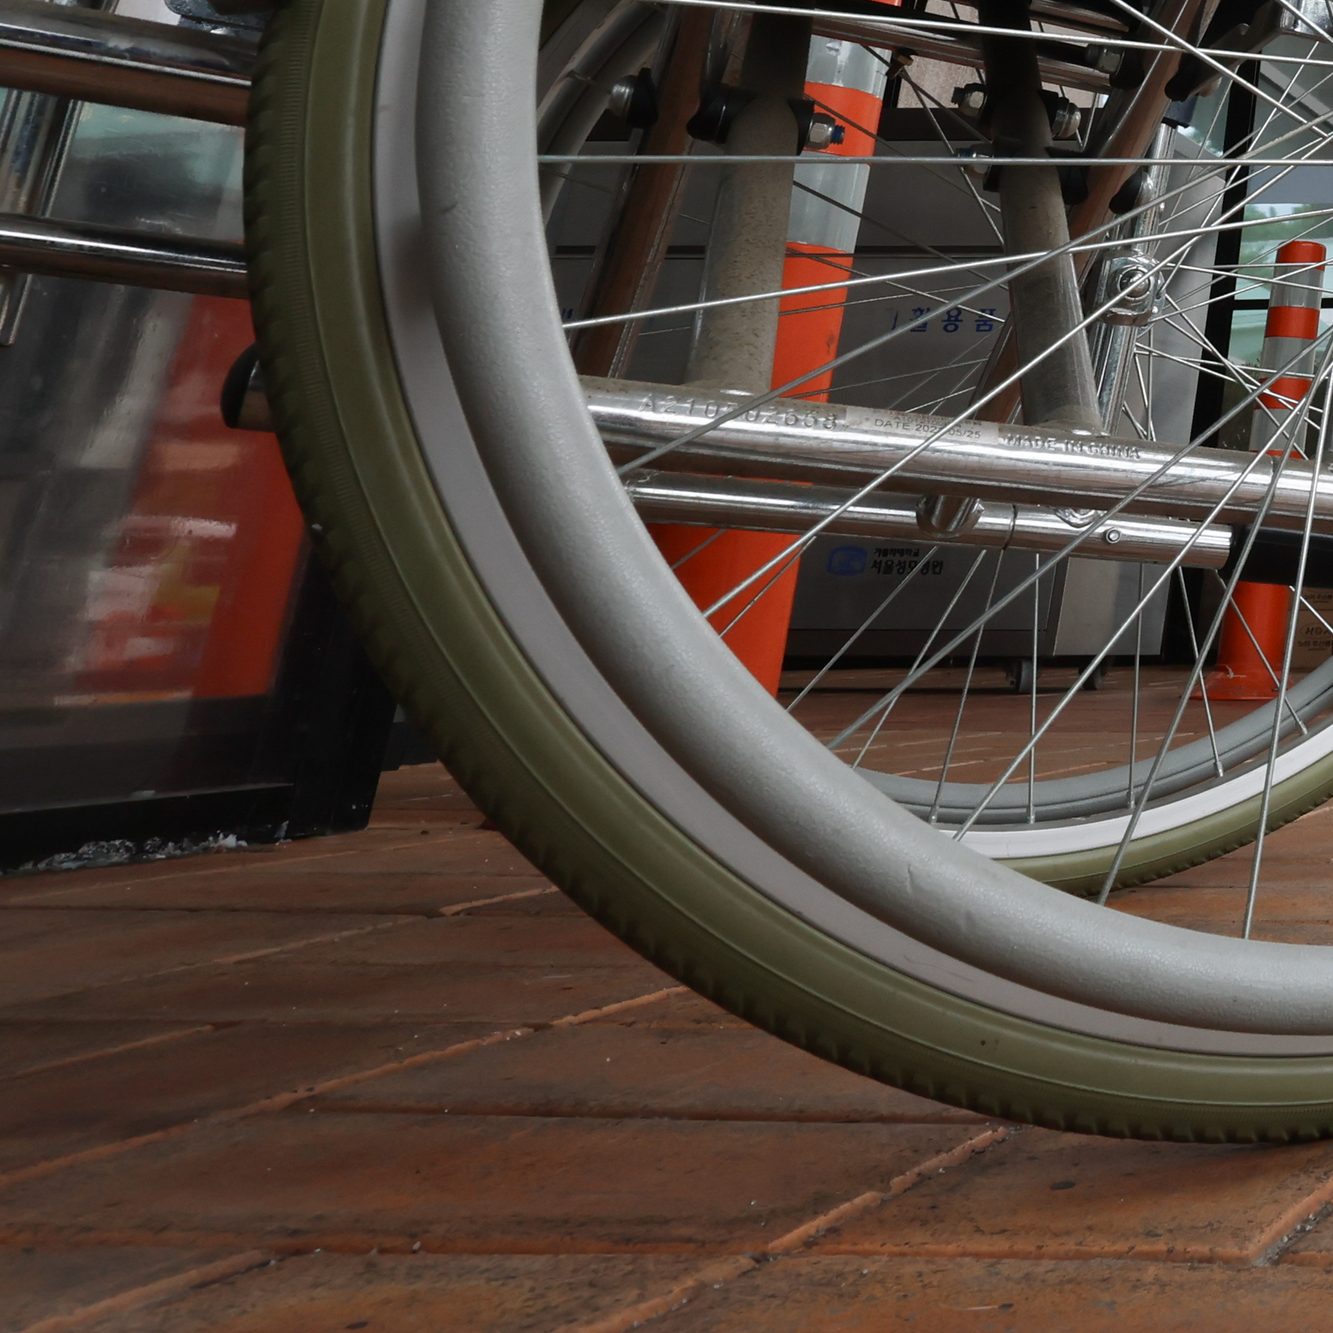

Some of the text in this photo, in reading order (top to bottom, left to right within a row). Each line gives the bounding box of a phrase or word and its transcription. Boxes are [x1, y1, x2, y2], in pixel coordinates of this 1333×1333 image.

[891, 307, 997, 333] 활용품
[1006, 433, 1056, 451] MADE
[1087, 442, 1141, 460] CHINA
[870, 559, 944, 576] 서울성모병원
